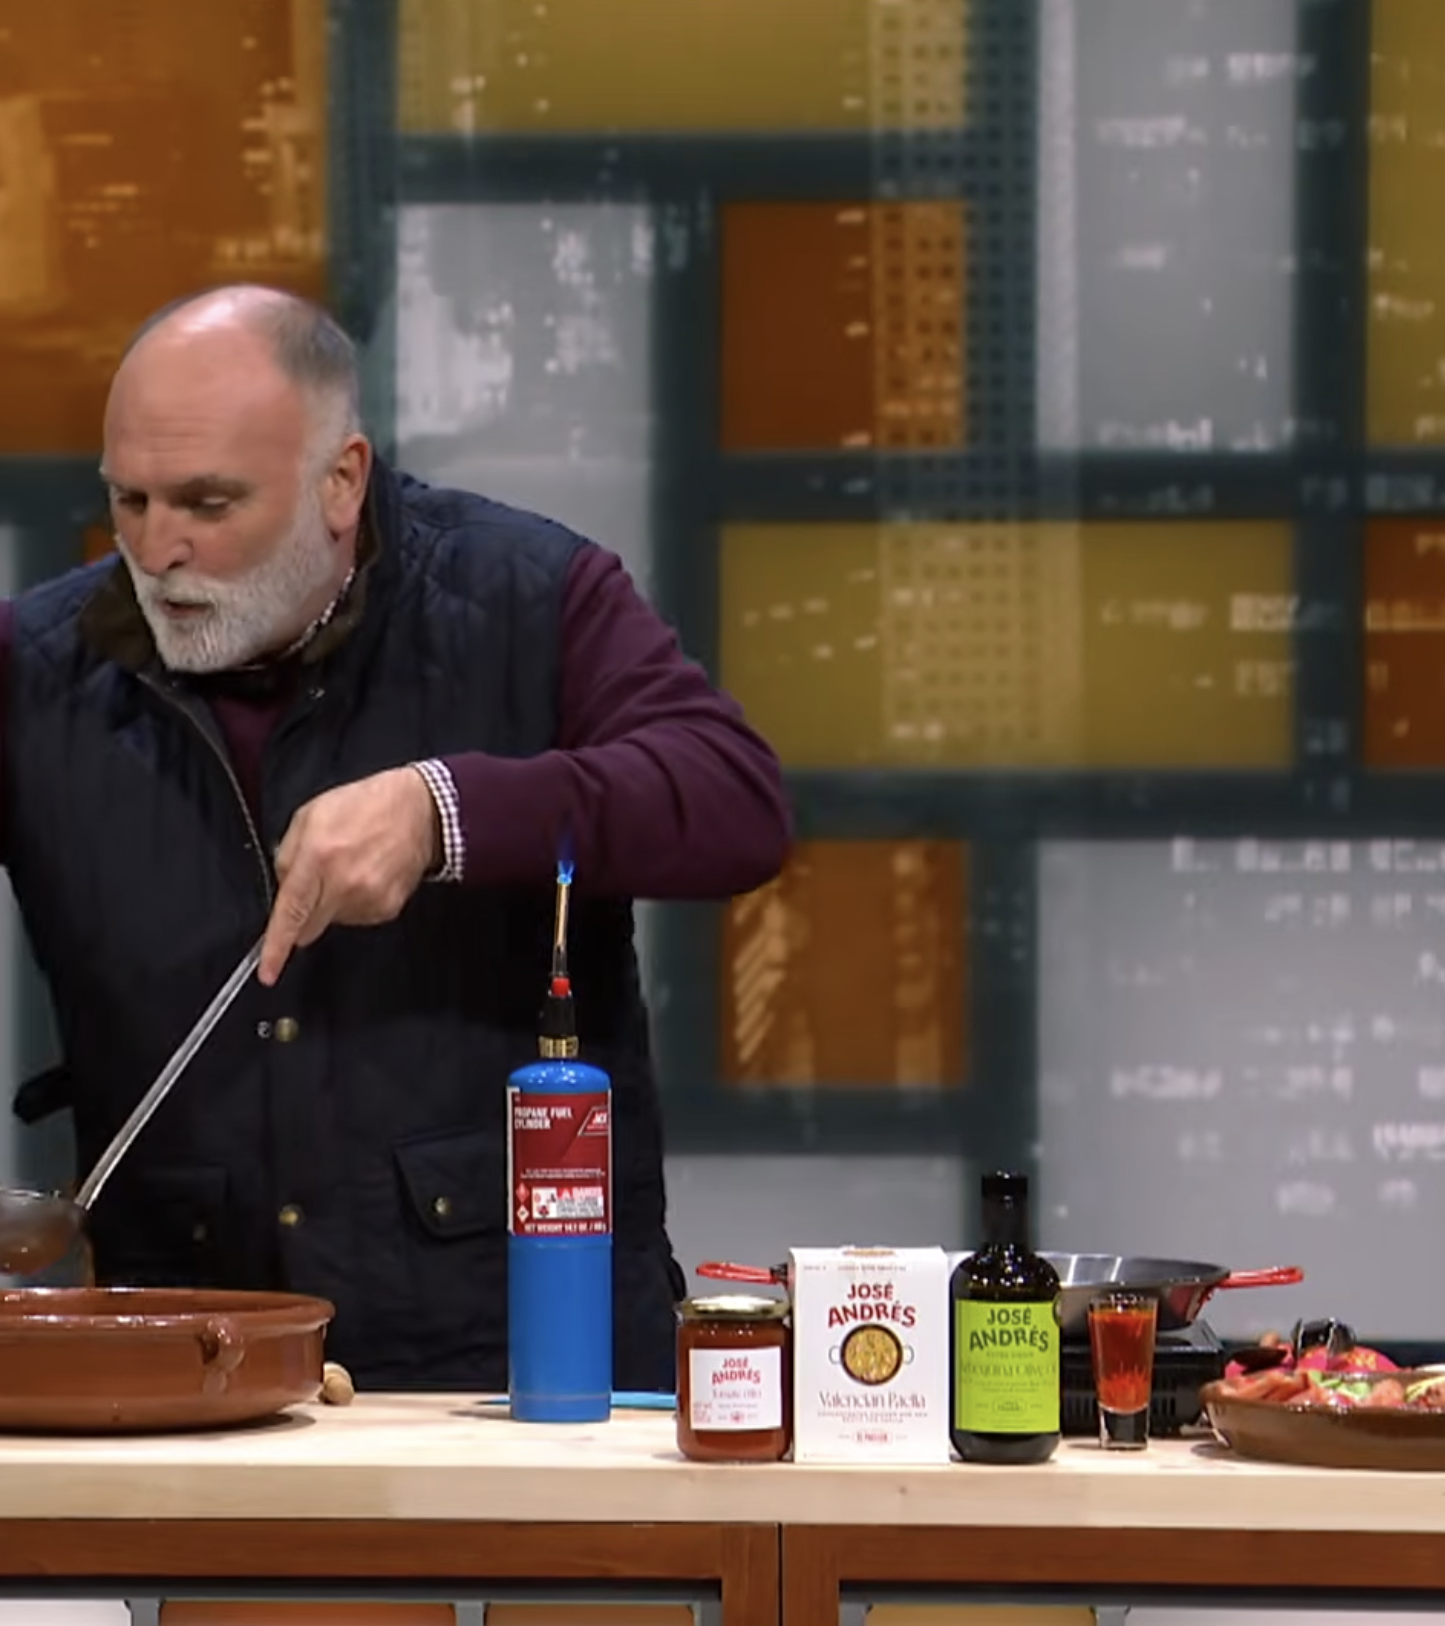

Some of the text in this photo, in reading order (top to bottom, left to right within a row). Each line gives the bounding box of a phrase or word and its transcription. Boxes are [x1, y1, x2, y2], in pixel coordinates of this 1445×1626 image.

[514, 1107, 573, 1119] PROPANE FUEL
[592, 1112, 608, 1124] ACE
[514, 1119, 551, 1131] CYLINDER
[847, 1282, 894, 1301] JOSÉ
[828, 1300, 916, 1329] ANDRÉS
[986, 1305, 1032, 1326] JOSÉ
[969, 1325, 1049, 1353] ANDRÉS
[722, 1356, 749, 1369] JOSÉ
[712, 1367, 761, 1387] ANDRÉS
[887, 1390, 926, 1409] Paella
